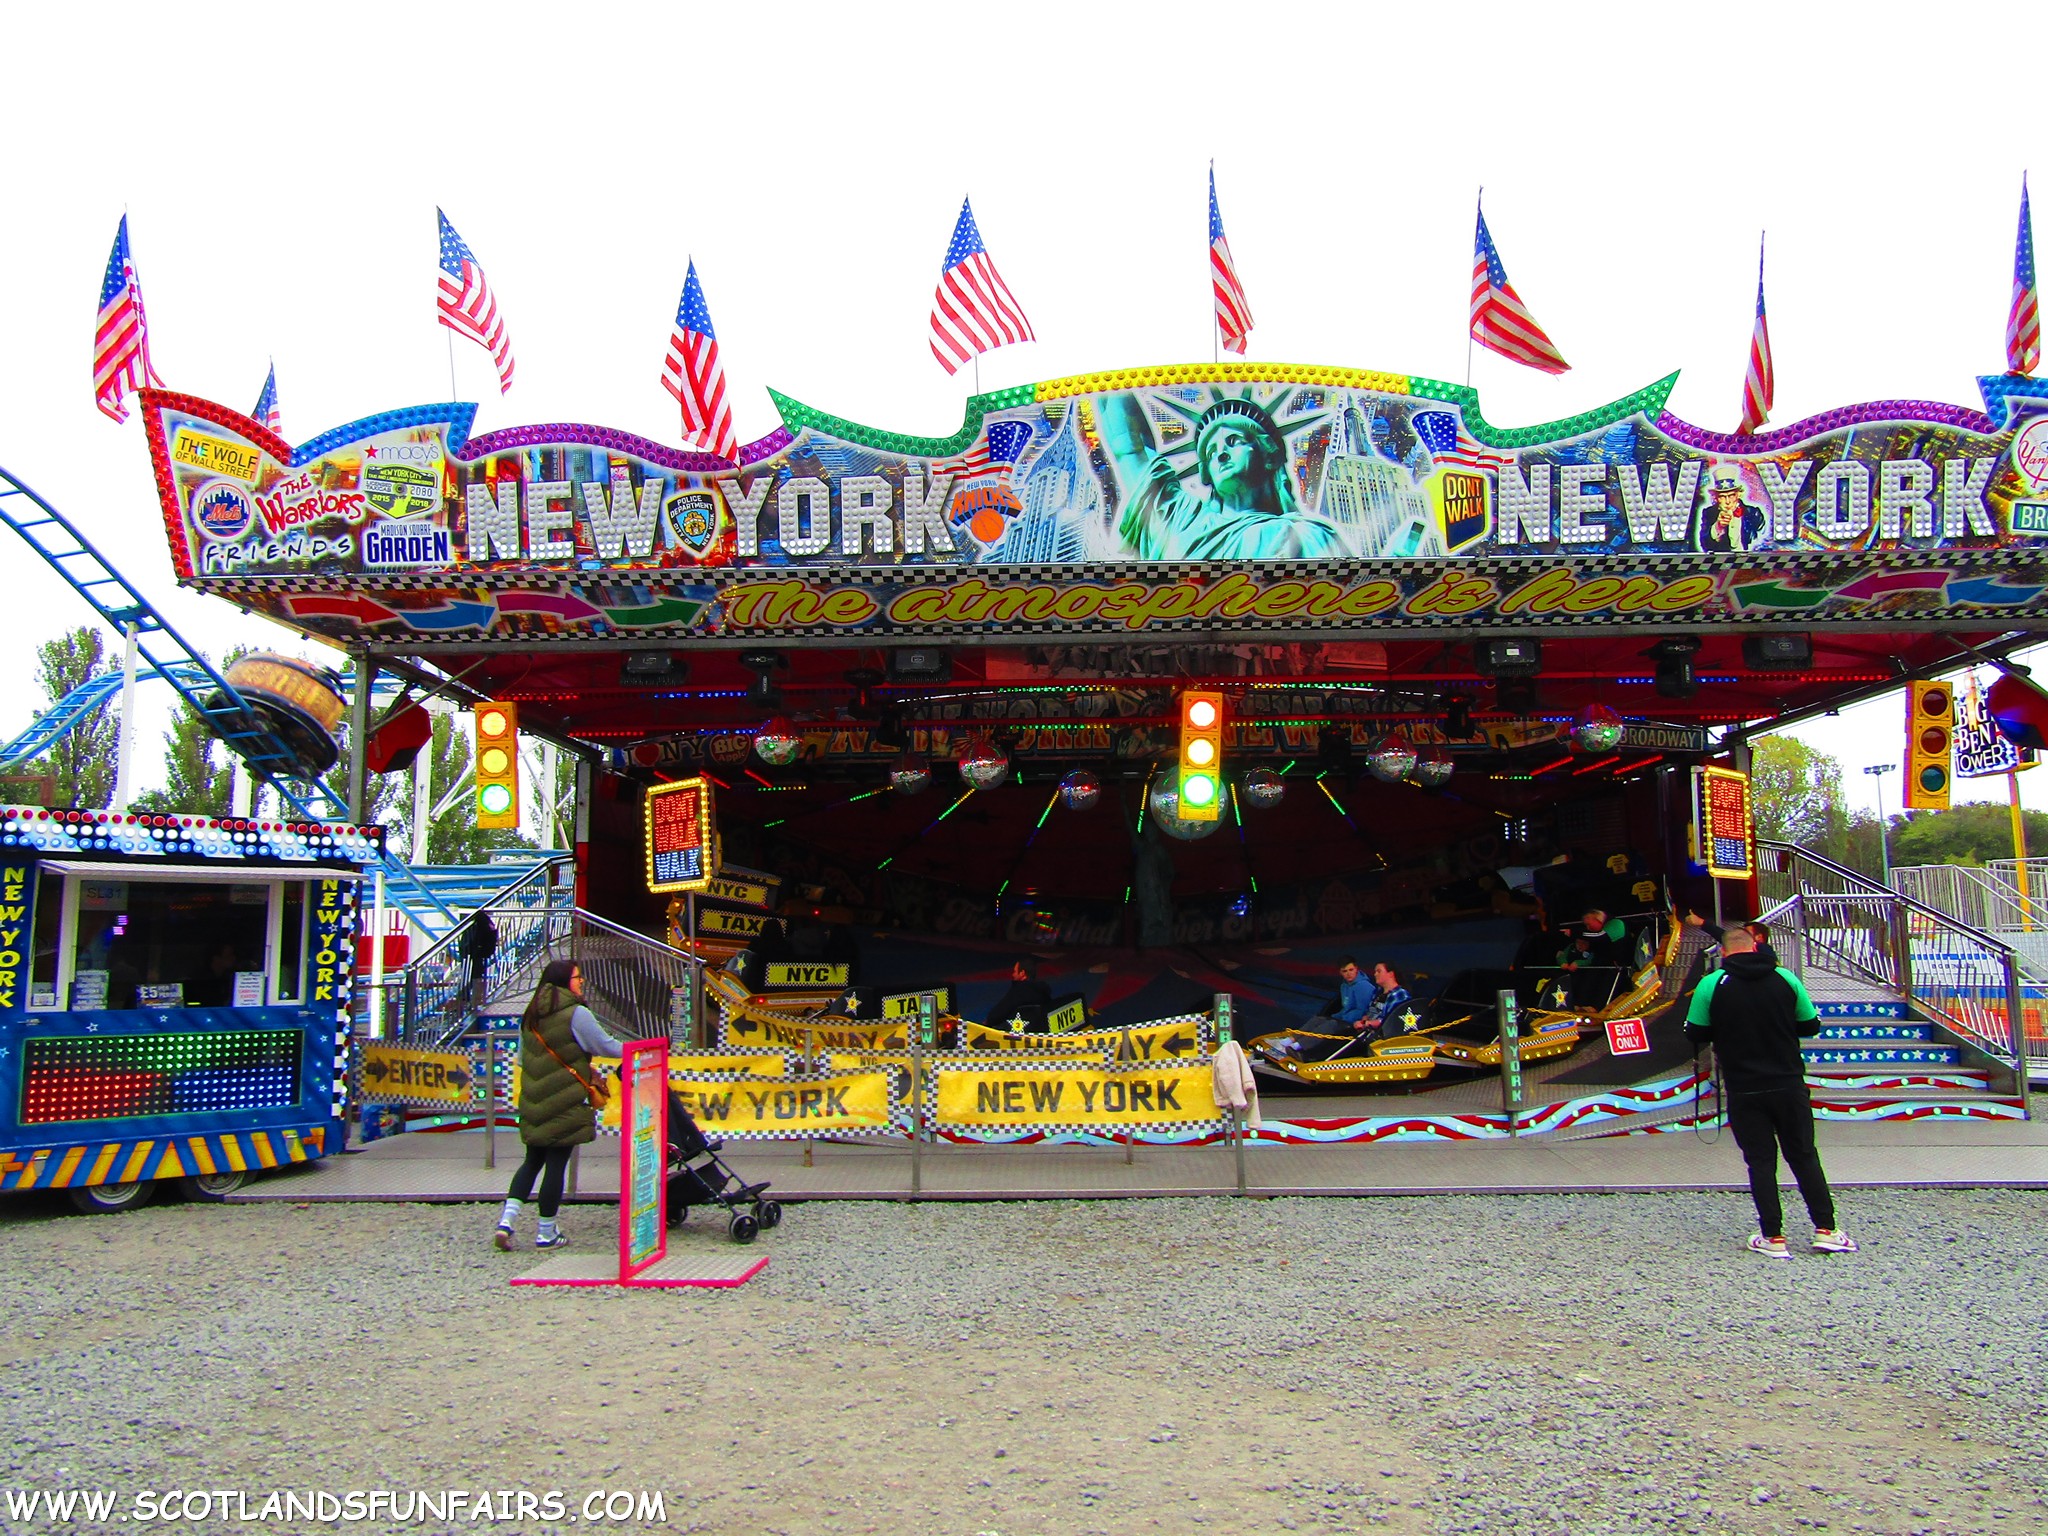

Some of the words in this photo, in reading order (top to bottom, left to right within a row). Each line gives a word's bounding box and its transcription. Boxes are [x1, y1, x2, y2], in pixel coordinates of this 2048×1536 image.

[175, 450, 188, 460] OF
[190, 454, 216, 469] WALL
[217, 461, 255, 479] STREET
[180, 436, 210, 456] THE
[214, 445, 258, 468] WOLF
[381, 443, 439, 463] macy's
[280, 473, 312, 496] THE
[394, 469, 409, 478] YORK
[966, 480, 979, 490] NEW
[373, 494, 390, 502] 2015
[411, 486, 433, 497] 2080
[677, 495, 702, 506] POLICE
[1446, 476, 1481, 499] DONT
[1757, 457, 1997, 540] YORK
[206, 503, 241, 521] Mets
[670, 502, 713, 519] DEPARTMENT
[949, 484, 1023, 520] KNICKS
[1446, 497, 1483, 523] WALK
[1498, 462, 1700, 545] NEW
[466, 478, 664, 562] NEW
[718, 473, 958, 558] YORK
[381, 525, 407, 536] MADISON
[409, 524, 431, 535] SQUARE
[366, 531, 448, 563] GARDEN
[727, 581, 876, 624] The
[890, 572, 1400, 629] atmosphere
[1405, 571, 1496, 615] is
[1500, 568, 1714, 613] here
[713, 736, 748, 754] BIG
[1620, 728, 1697, 748] BROADWAY
[1959, 722, 1991, 754] BEN
[720, 750, 747, 762] Apple
[1954, 743, 2004, 771] TOWER
[655, 849, 700, 880] WALK
[0, 867, 26, 922] NEW
[316, 880, 340, 923] NEW
[707, 880, 748, 898] NYC
[720, 915, 761, 932] TAX
[0, 929, 21, 1008] YORK
[315, 933, 336, 1000] YORK
[786, 967, 829, 982] NYC
[140, 986, 158, 998] £5
[920, 1003, 932, 1043] NEW
[1056, 1008, 1076, 1030] NYC
[1505, 996, 1518, 1038] NEW
[1615, 1023, 1635, 1036] EXIT
[817, 1031, 877, 1049] WAY
[1617, 1036, 1640, 1049] ONLY
[389, 1058, 447, 1088] ENTER
[1509, 1045, 1522, 1102] YORK
[674, 1090, 733, 1120] EW
[746, 1086, 850, 1120] YORK
[977, 1081, 1064, 1112] NEW
[1076, 1078, 1183, 1112] YORK
